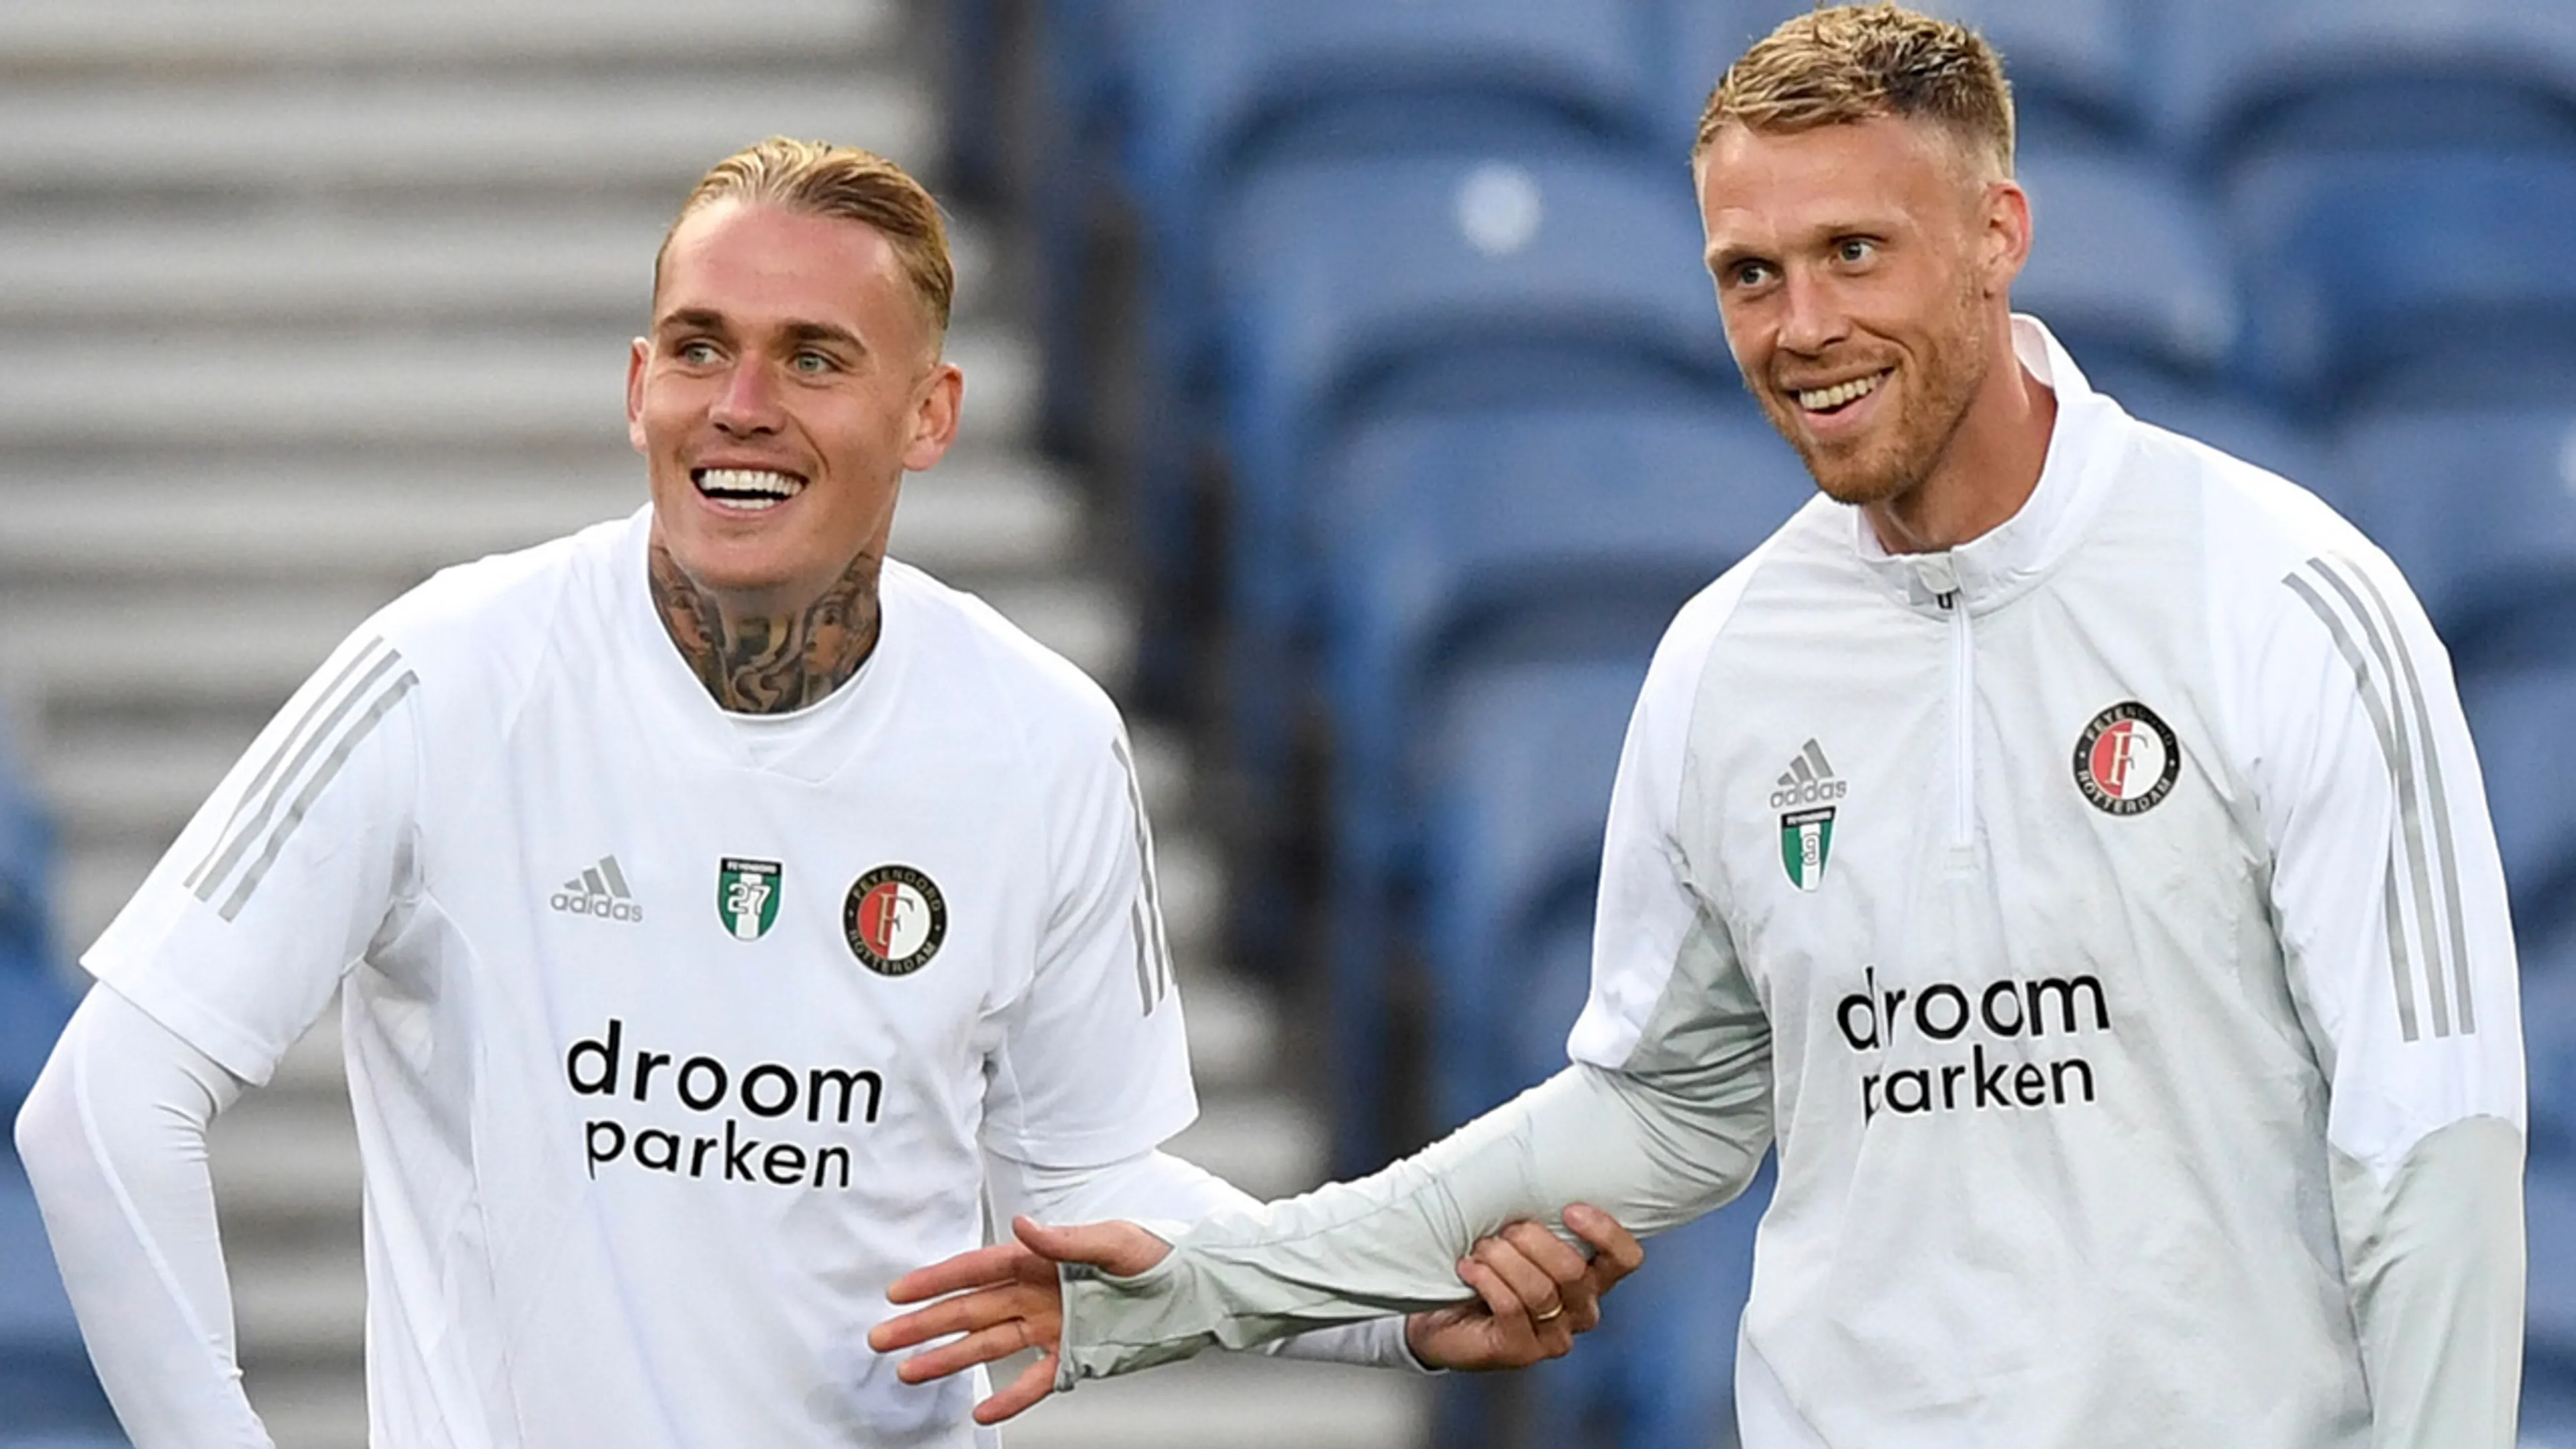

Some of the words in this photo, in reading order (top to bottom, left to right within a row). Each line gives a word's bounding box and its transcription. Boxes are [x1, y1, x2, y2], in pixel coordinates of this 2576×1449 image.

[2086, 706, 2175, 745] FEYENOD
[2104, 731, 2148, 786] F
[1770, 778, 1847, 808] adidas
[2078, 771, 2171, 813] ROTTERDAM
[1802, 833, 1821, 866] 9
[550, 891, 643, 922] adidas
[727, 883, 771, 914] 27
[853, 869, 941, 911] FEYENOORD
[875, 892, 914, 947] F
[849, 929, 936, 973] ROTTERDAM
[1837, 966, 2110, 1050] droom
[568, 1018, 882, 1122] droom
[586, 1120, 849, 1187] parken
